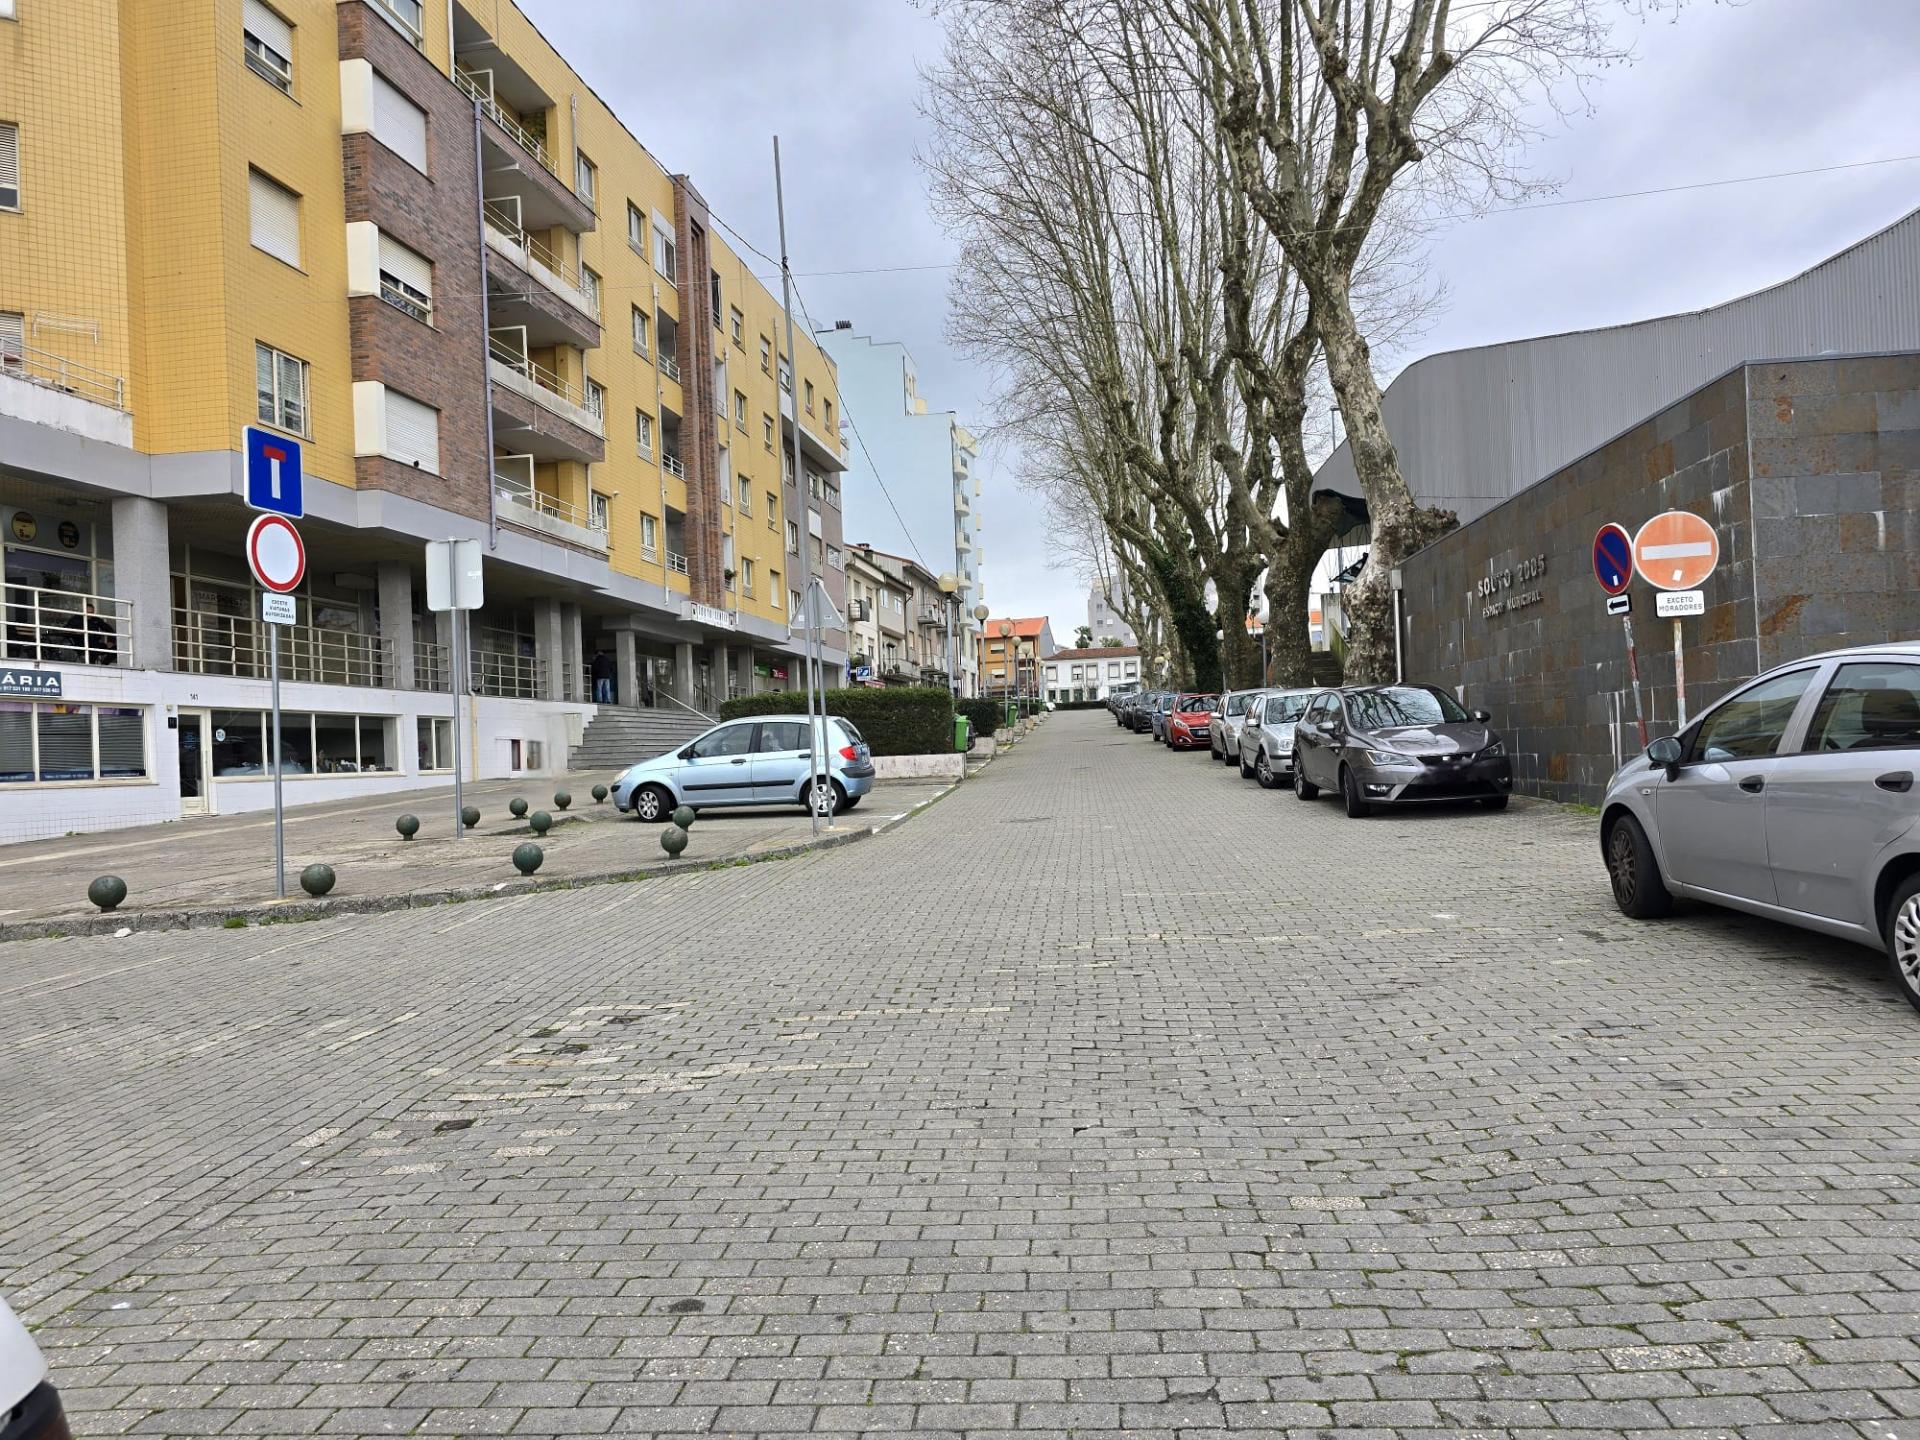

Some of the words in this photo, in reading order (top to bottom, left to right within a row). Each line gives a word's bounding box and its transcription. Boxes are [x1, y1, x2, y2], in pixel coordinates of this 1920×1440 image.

[1517, 554, 1545, 582] 2005
[1666, 596, 1694, 604] EXCETO
[1658, 603, 1703, 612] MORADORES
